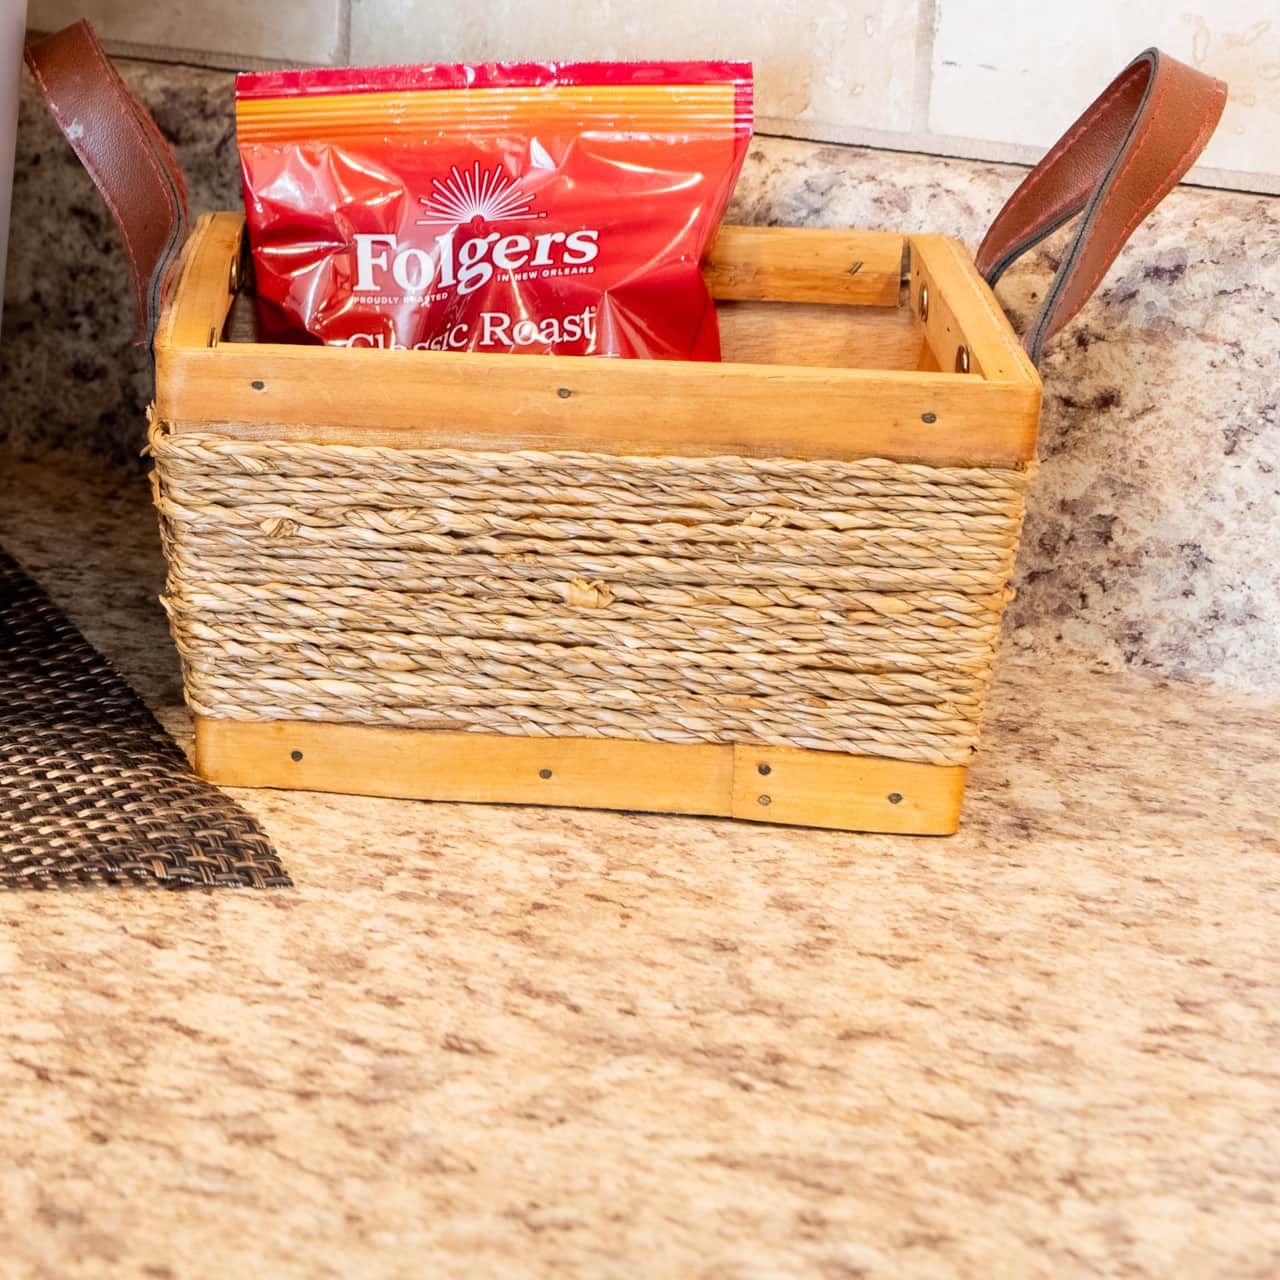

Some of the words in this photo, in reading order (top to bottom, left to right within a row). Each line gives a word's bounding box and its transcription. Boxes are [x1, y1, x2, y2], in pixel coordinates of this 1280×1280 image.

[352, 229, 599, 296] Folgers
[496, 273, 510, 282] IN
[514, 271, 538, 281] NEW
[542, 266, 595, 278] ORLEANS
[353, 295, 400, 305] PROUDLY
[403, 292, 449, 307] RASTED
[480, 306, 597, 346] Roast
